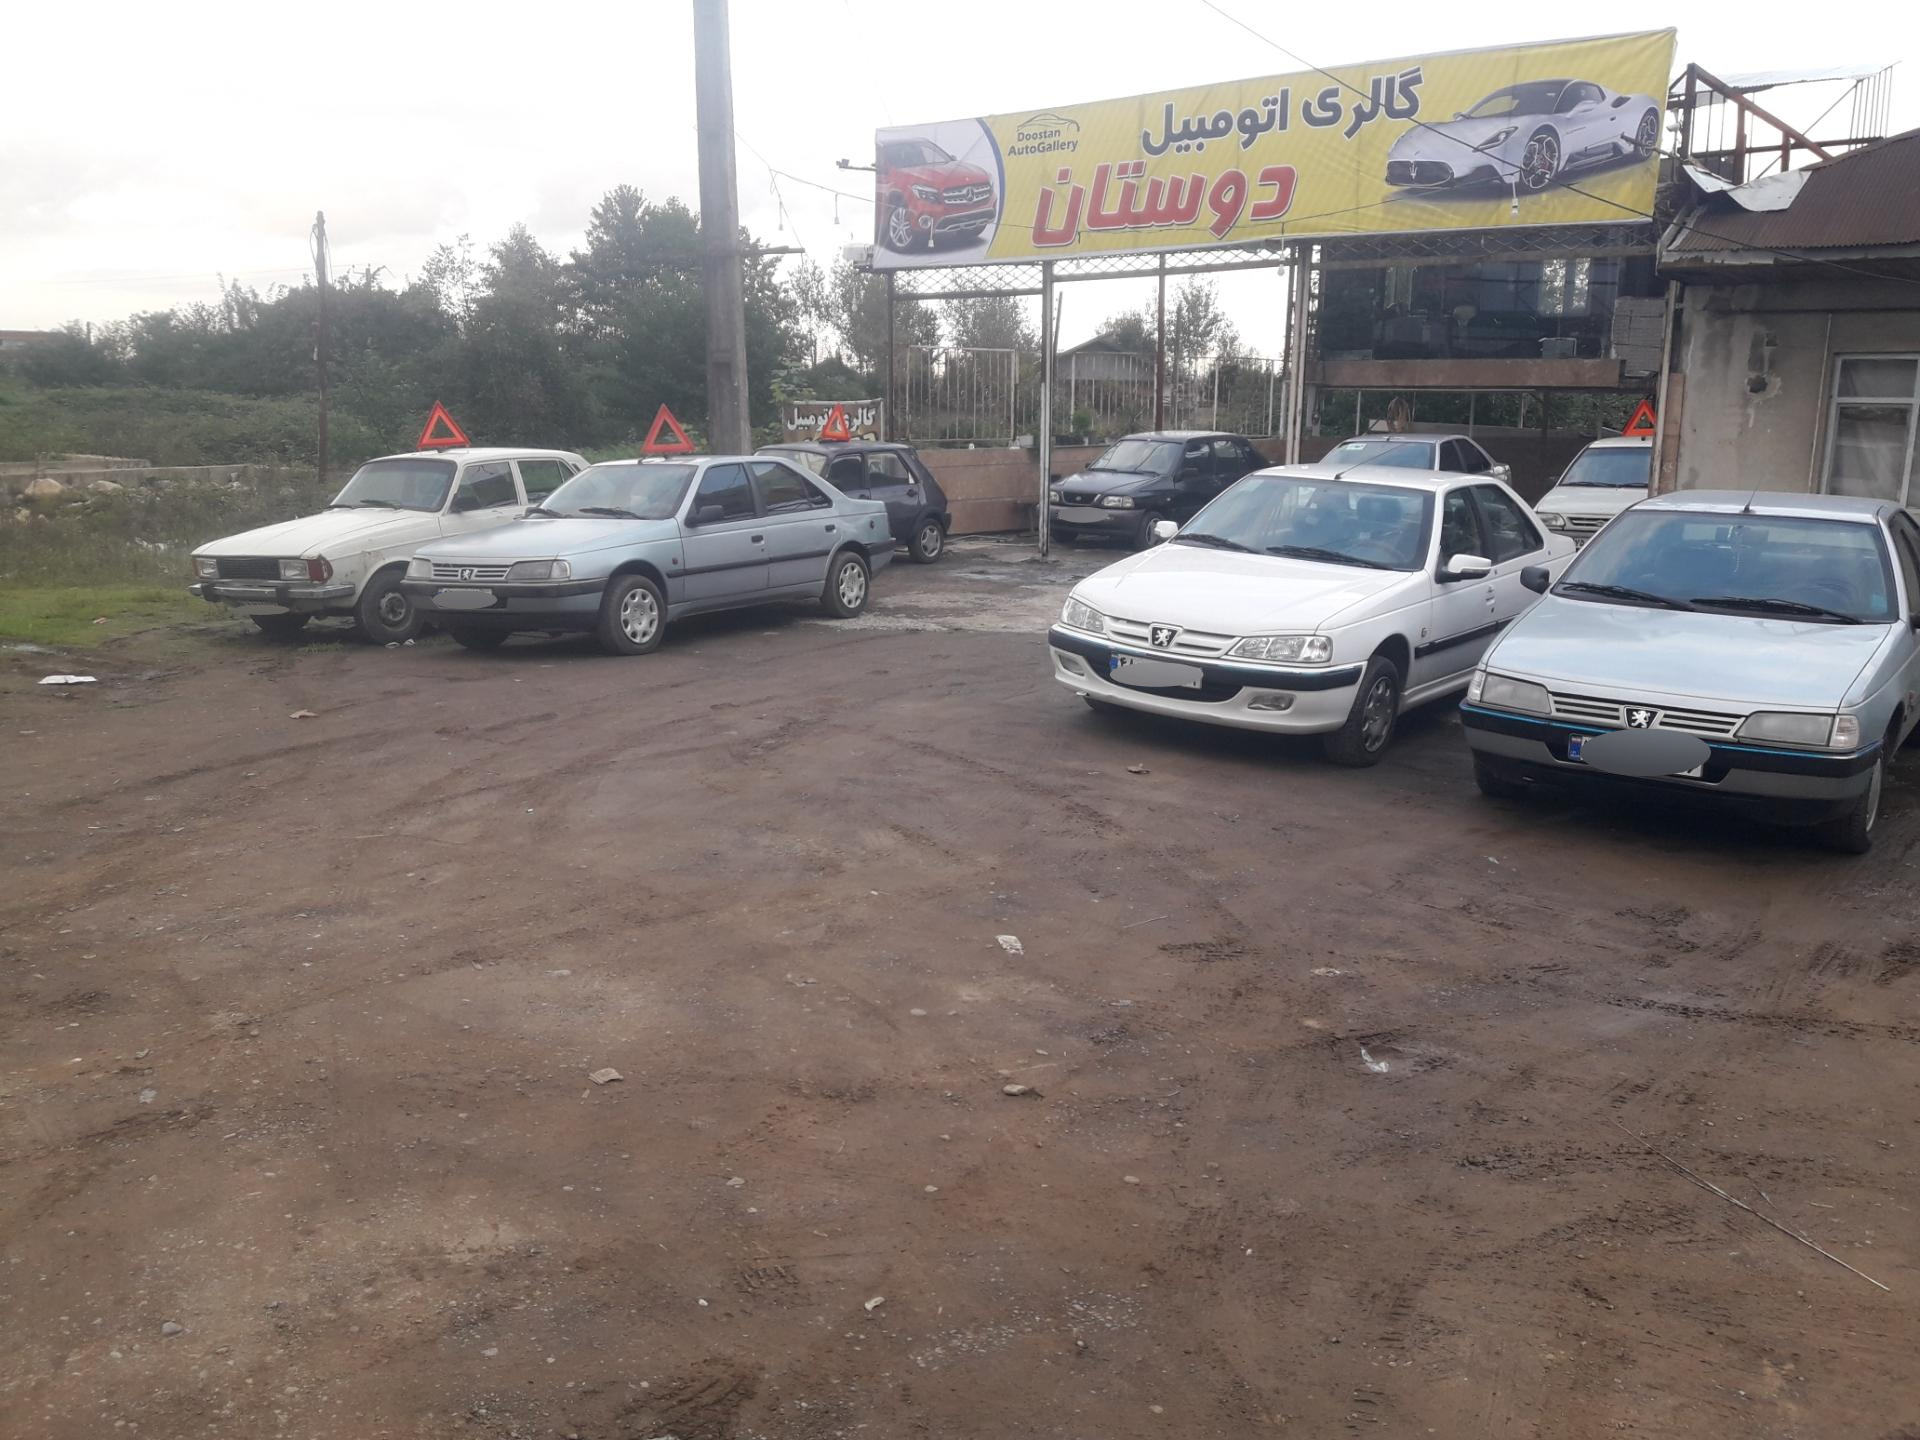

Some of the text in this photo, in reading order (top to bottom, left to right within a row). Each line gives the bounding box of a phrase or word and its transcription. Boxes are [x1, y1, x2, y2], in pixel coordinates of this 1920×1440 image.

[1017, 129, 1061, 142] Doostan
[1142, 67, 1423, 156] گالری اتومبیل
[1008, 140, 1078, 156] AutoGallery
[1032, 160, 1297, 247] دوستان
